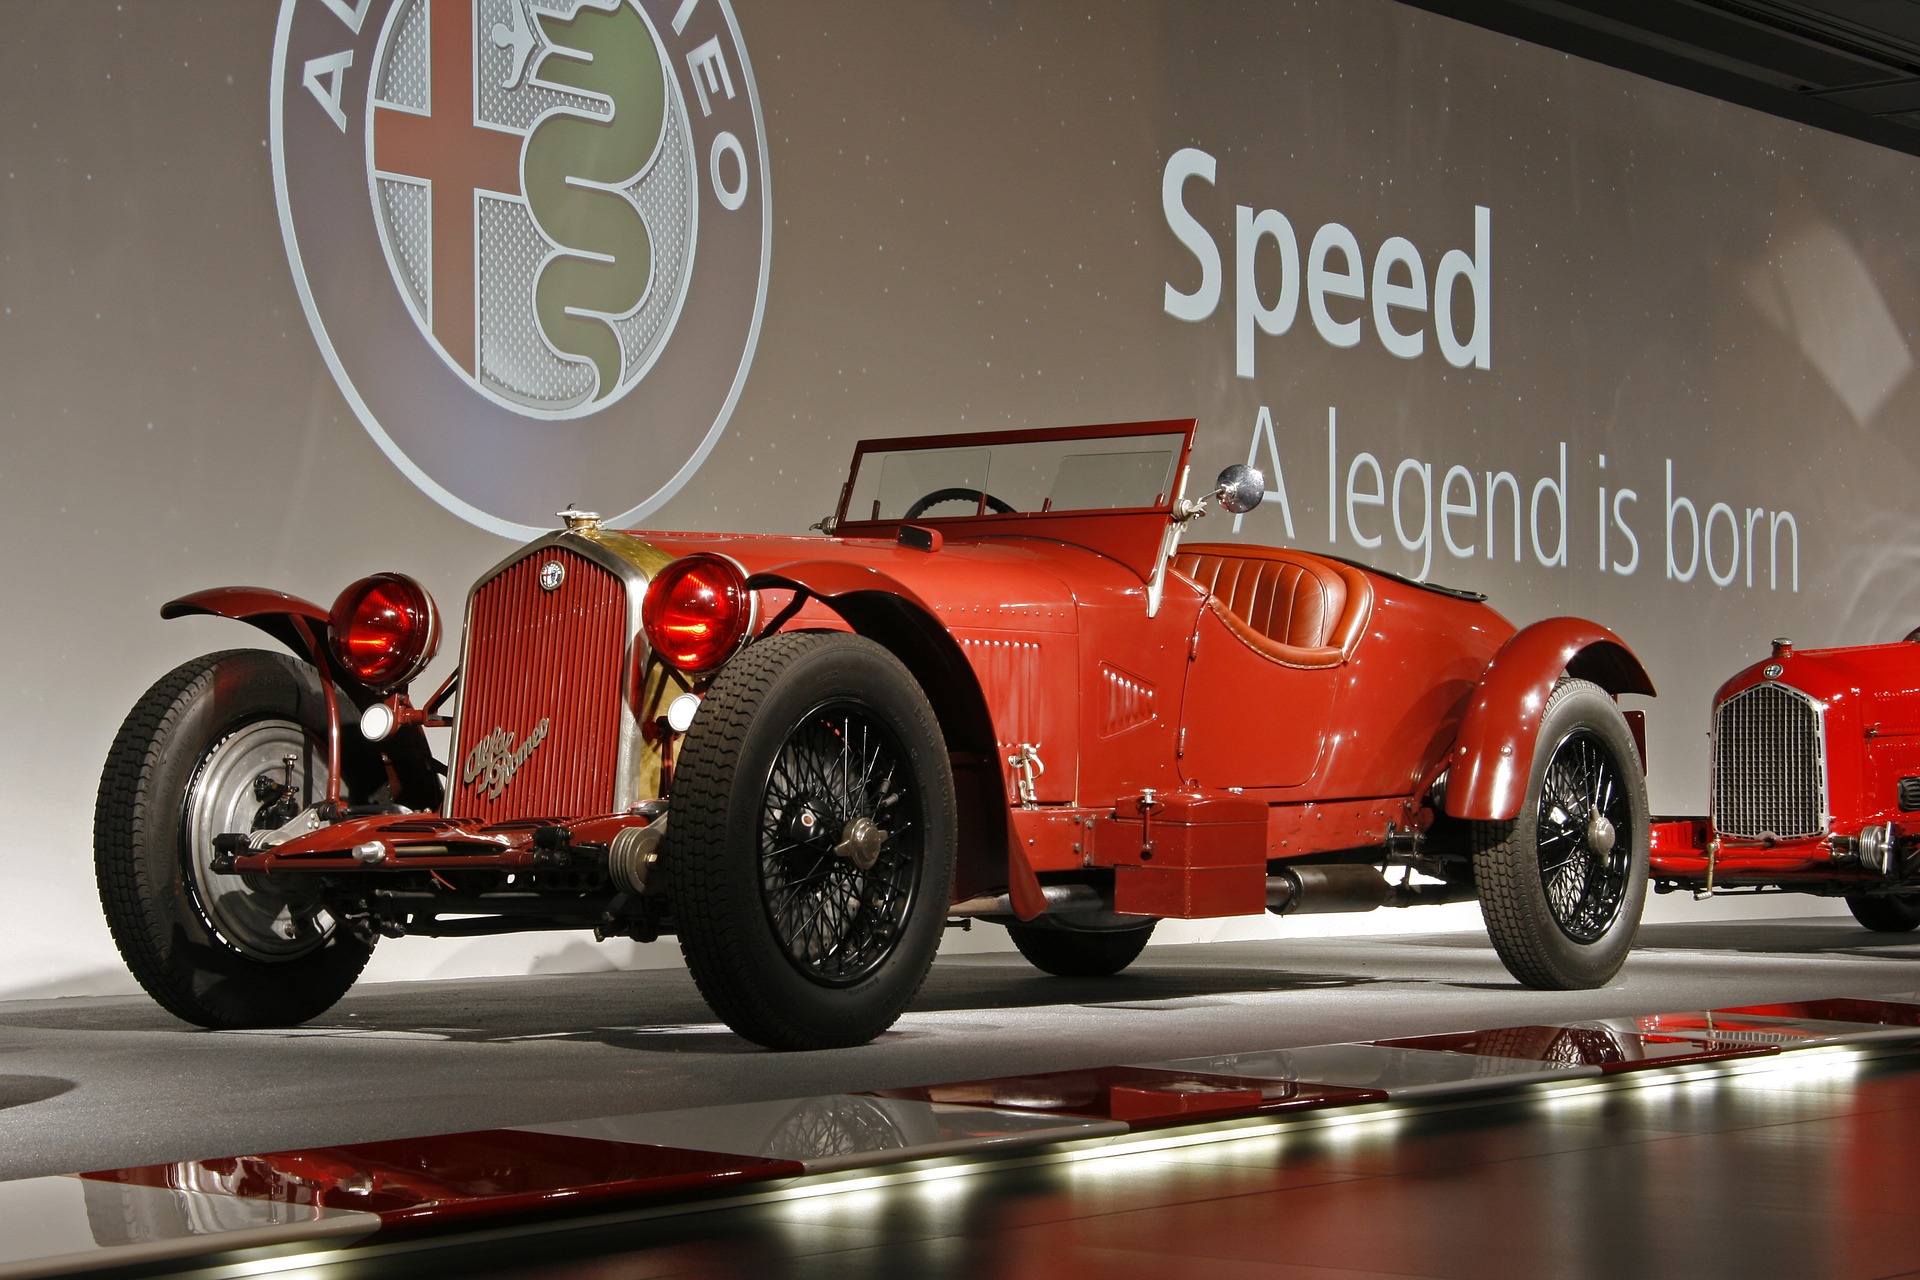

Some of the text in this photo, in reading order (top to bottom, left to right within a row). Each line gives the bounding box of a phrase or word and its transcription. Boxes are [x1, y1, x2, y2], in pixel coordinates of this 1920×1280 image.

[1162, 147, 1490, 378] Speed
[1231, 405, 1799, 592] A legend is born
[463, 726, 515, 794] Alfa
[487, 717, 550, 800] Romeo
